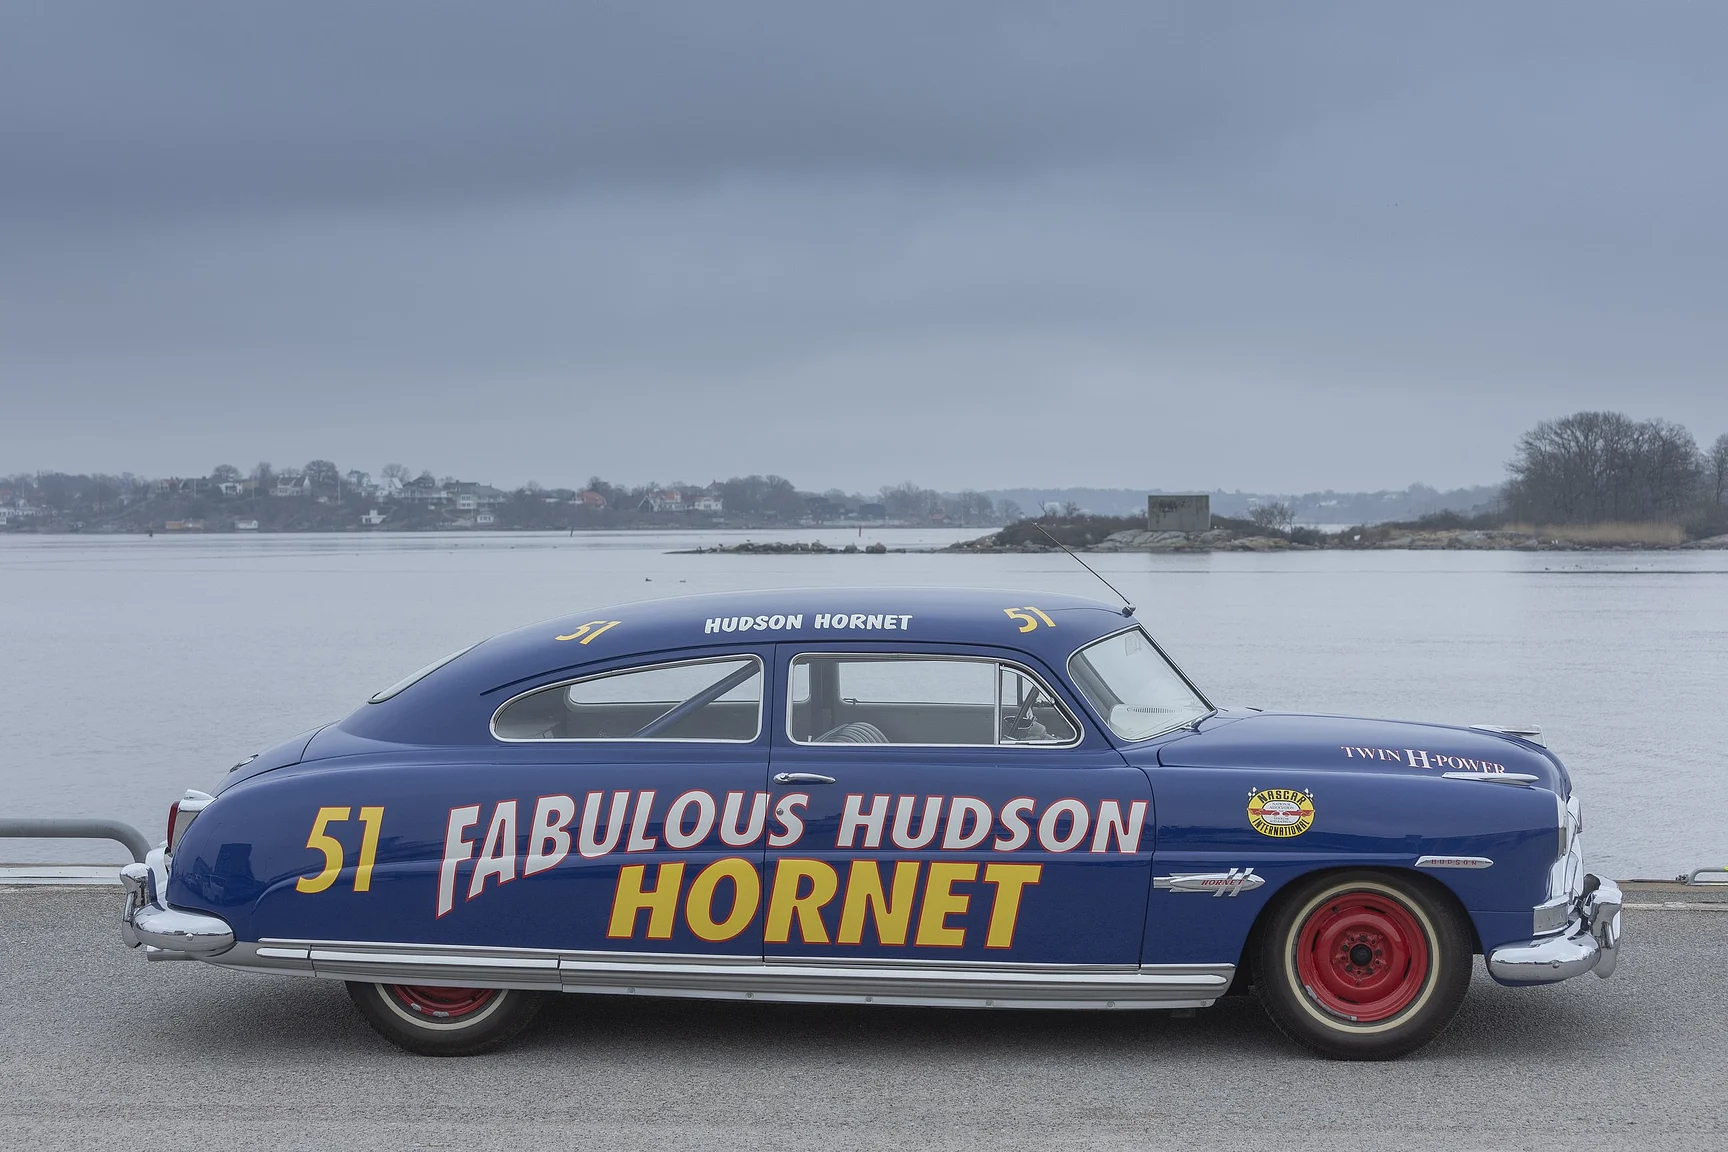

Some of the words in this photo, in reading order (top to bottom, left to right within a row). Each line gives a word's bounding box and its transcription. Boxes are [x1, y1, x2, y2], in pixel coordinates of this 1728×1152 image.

[704, 614, 803, 634] HUDSON
[814, 613, 913, 630] HORNET
[1002, 606, 1056, 633] 51
[554, 620, 622, 645] 51
[1340, 746, 1401, 762] TWIN
[1257, 790, 1307, 805] NASCAR
[1252, 817, 1310, 836] INTERNATIONAL
[295, 806, 386, 895] 51
[436, 788, 810, 919] FABULOUS
[834, 794, 1150, 855] HUDSON
[605, 857, 1043, 949] HORNET
